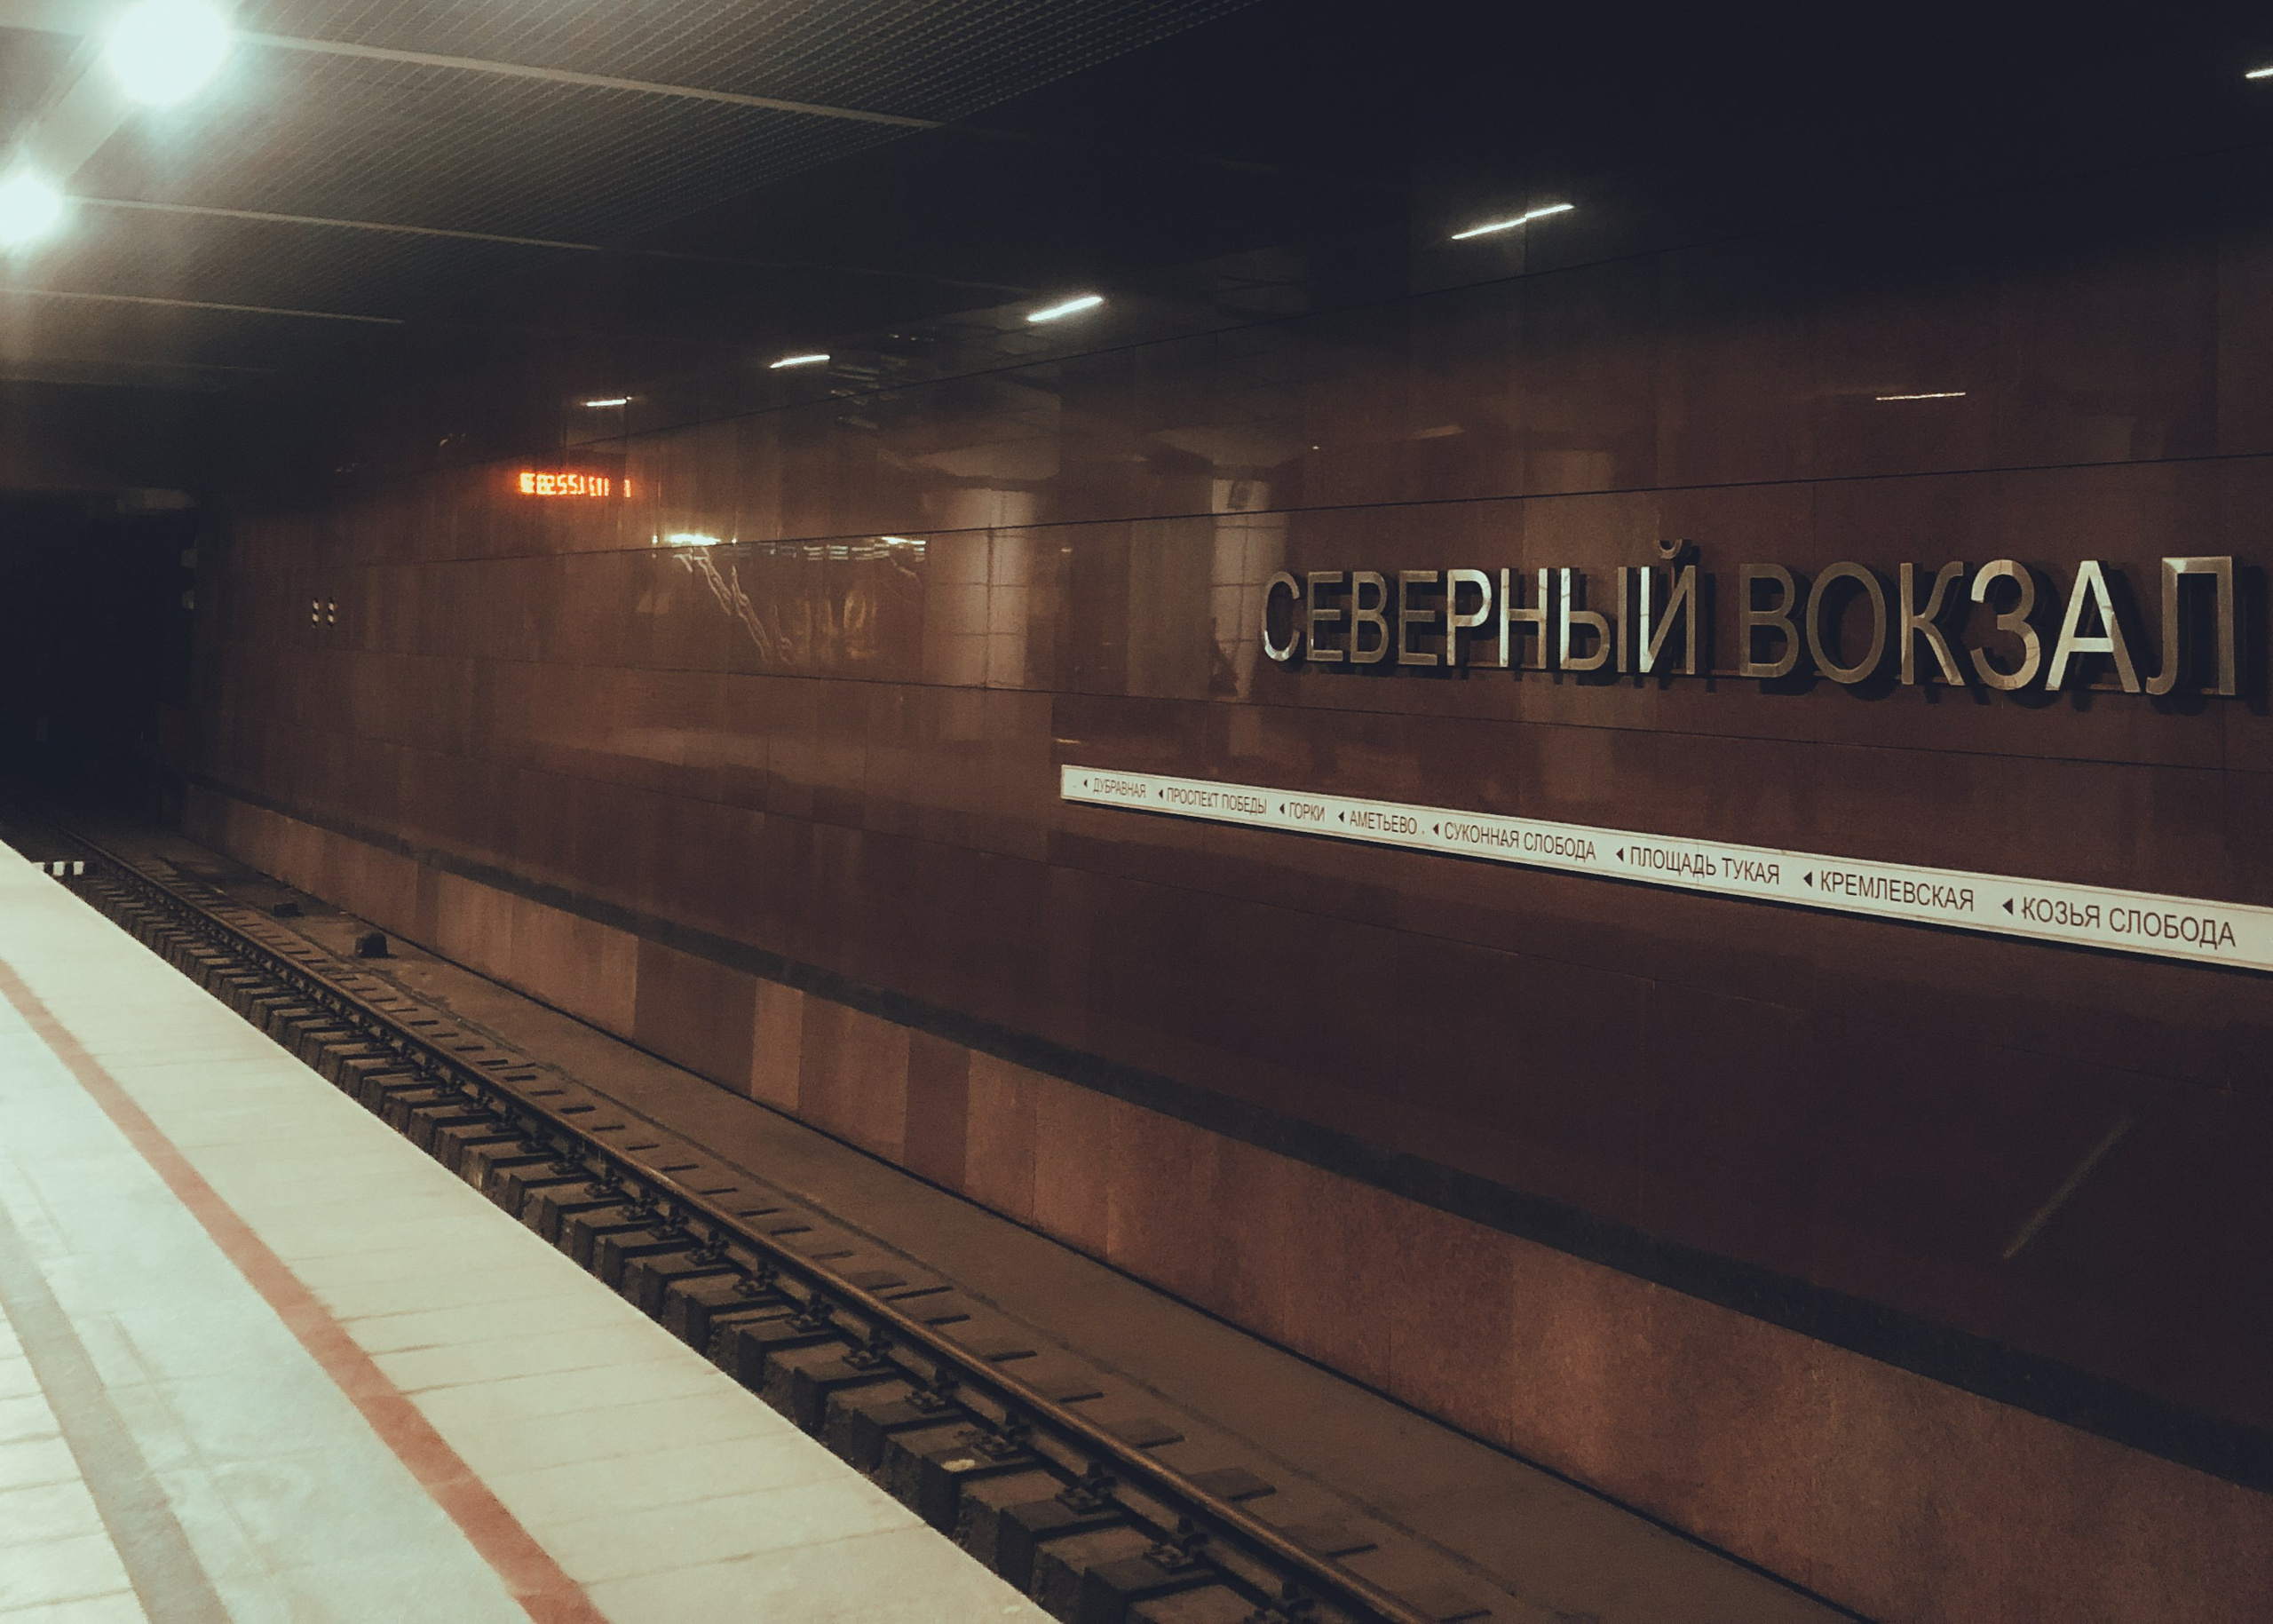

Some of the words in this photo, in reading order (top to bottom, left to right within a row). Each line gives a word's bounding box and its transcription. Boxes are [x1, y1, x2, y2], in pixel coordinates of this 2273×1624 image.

[1262, 538, 1697, 676] СЕВЕРНЫЙ
[1738, 555, 2237, 696] ВОКЗАЛ
[1093, 777, 1146, 798] ДУБРАВНАЯ
[1166, 787, 1219, 809] ПРОСПЕКТ
[1222, 794, 1268, 815] ПОБЕДЫ
[1288, 801, 1326, 822] ГОРКИ
[1349, 810, 1418, 836] АМЕТЬЕВО
[1444, 821, 1520, 849] СУКОННАЯ
[1524, 832, 1597, 862] СЛОБОДА
[1630, 846, 1716, 878] ПЛОЩАДЬ
[1722, 857, 1780, 886] ТУКАЯ
[1819, 870, 1975, 912] КРЕМЛЕВСКАЯ
[2022, 896, 2101, 929] КОЗЬЯ
[2109, 907, 2237, 950] СЛОБОДА
